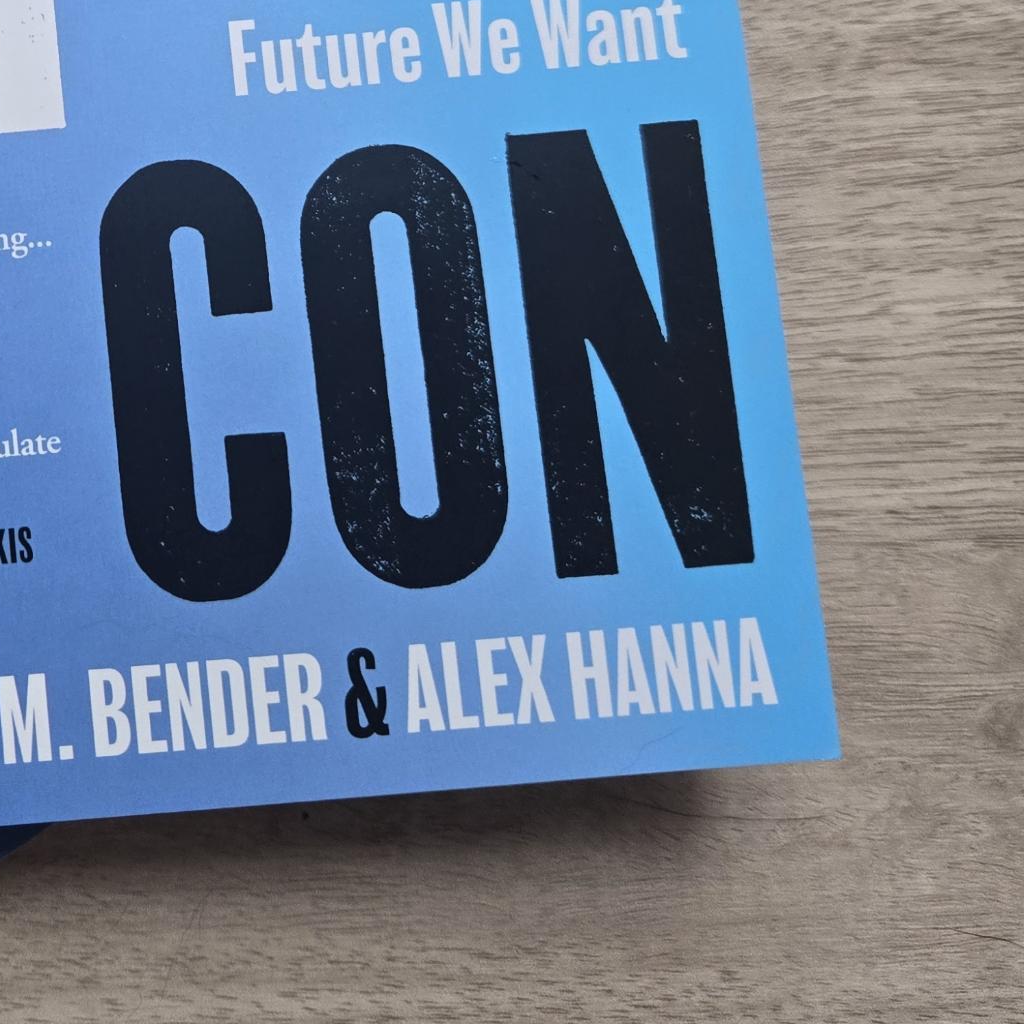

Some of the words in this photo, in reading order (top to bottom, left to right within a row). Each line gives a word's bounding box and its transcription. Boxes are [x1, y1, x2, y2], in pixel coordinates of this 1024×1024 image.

[226, 18, 423, 98] Future
[99, 119, 756, 603] CON
[90, 652, 328, 758] BENDER
[343, 647, 391, 741] &
[406, 633, 556, 734] ALEX
[565, 617, 779, 722] HANNA
